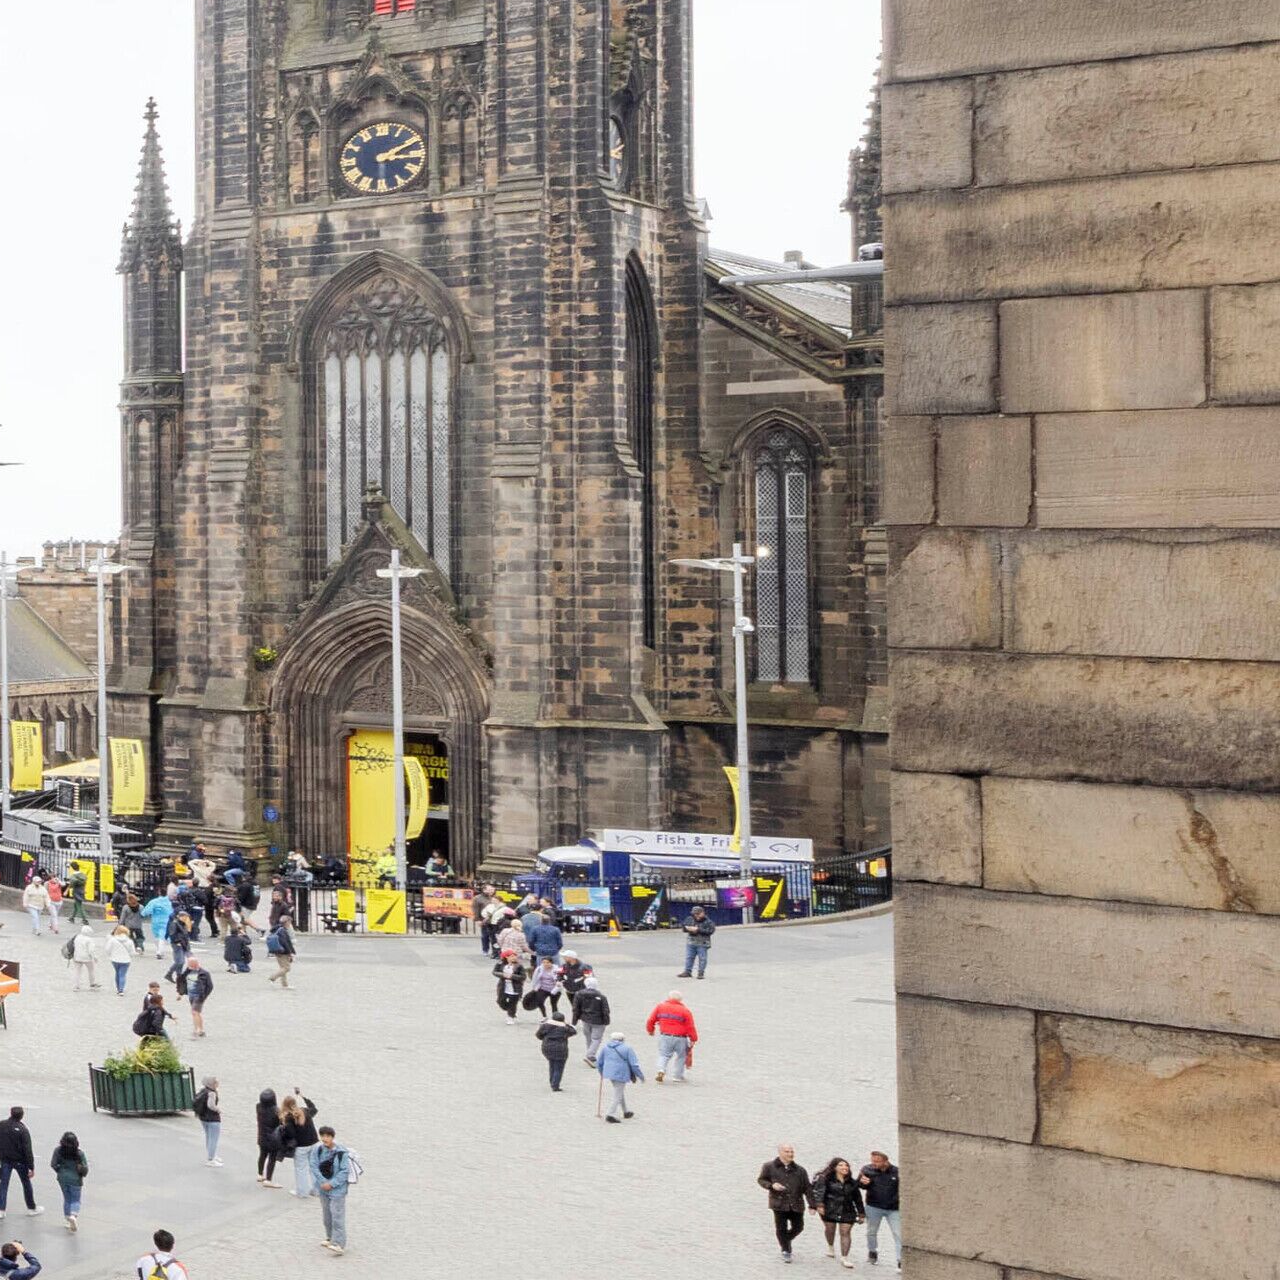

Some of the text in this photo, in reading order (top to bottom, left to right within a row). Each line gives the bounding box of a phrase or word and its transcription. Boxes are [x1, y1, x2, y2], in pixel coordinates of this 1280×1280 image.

[656, 834, 686, 845] Fish
[694, 836, 703, 846] &
[711, 836, 757, 849] Fris
